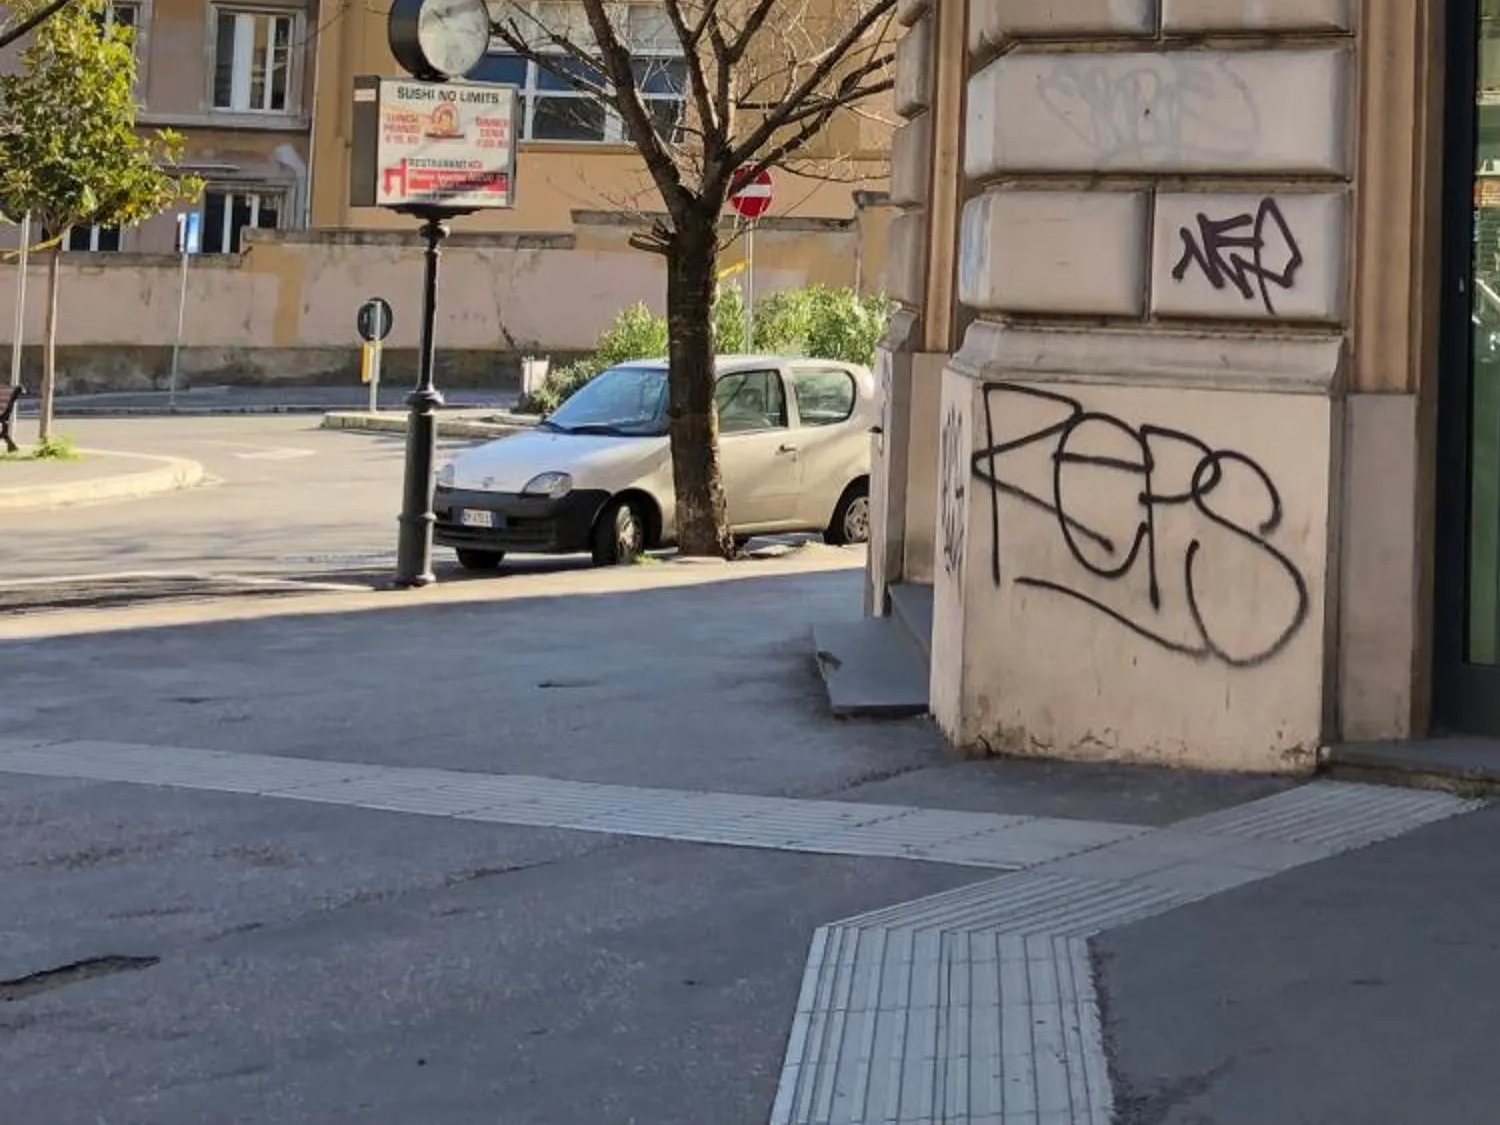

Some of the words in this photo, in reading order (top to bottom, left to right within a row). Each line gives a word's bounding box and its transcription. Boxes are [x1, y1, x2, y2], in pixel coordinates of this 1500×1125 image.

[396, 86, 435, 100] SUSHI
[439, 89, 457, 102] NO
[459, 90, 500, 104] LIMITS
